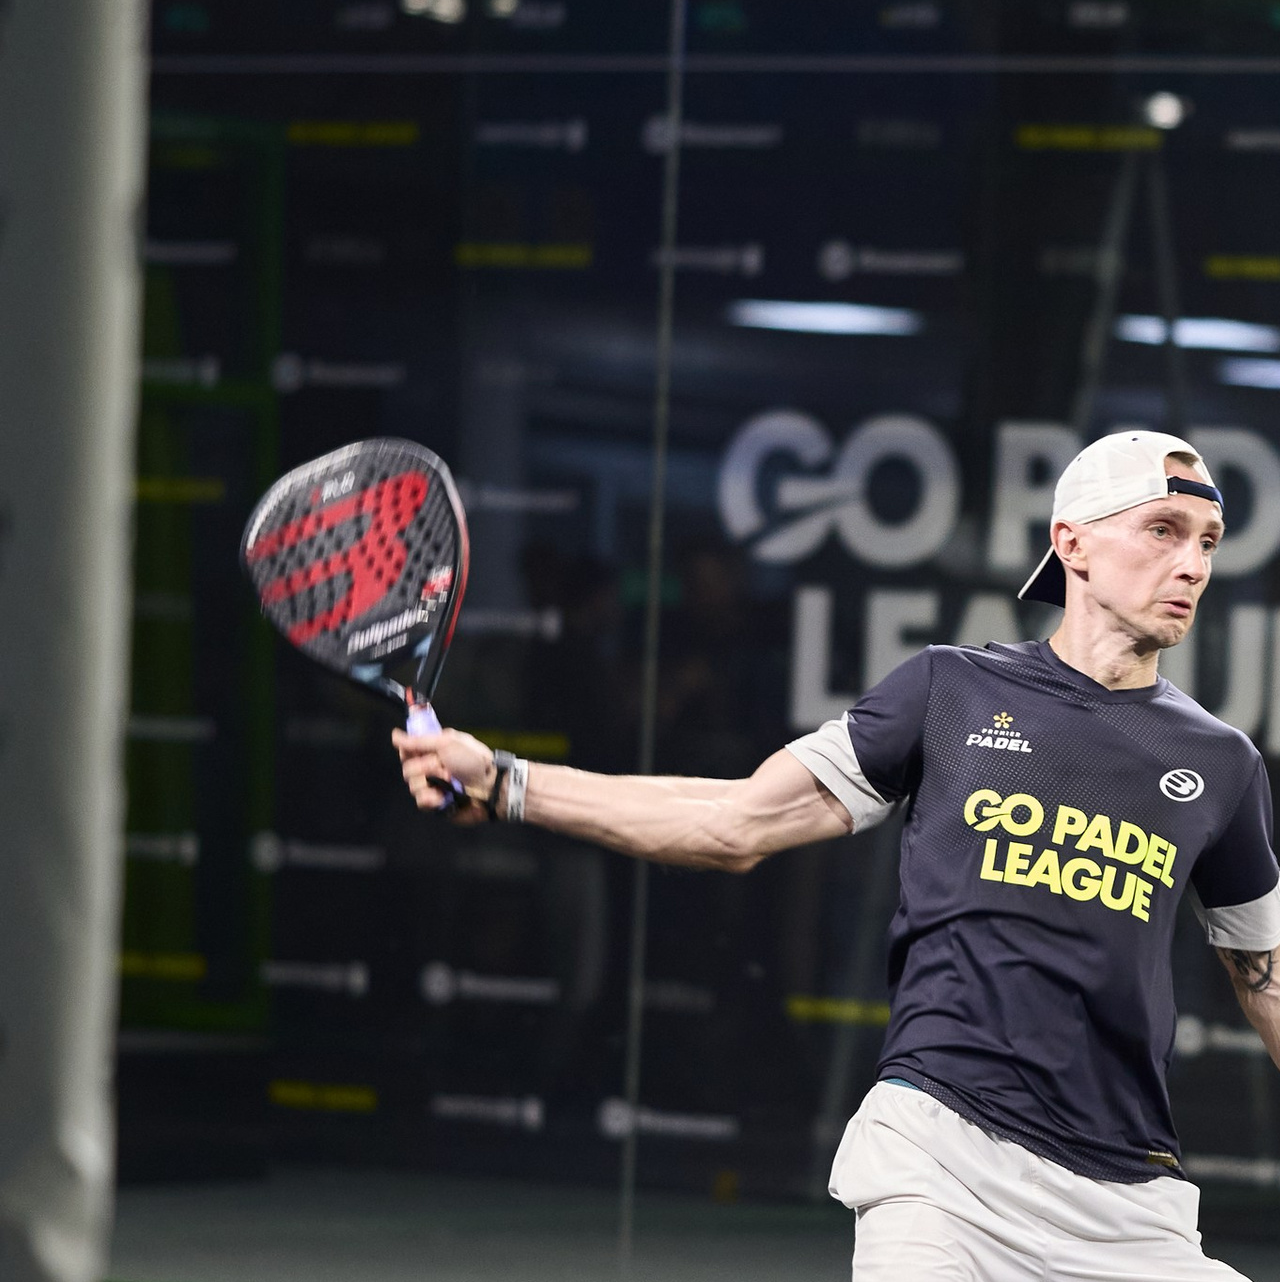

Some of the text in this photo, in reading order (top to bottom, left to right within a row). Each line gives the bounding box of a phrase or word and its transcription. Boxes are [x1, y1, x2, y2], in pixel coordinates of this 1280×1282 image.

[718, 409, 958, 567] GO
[966, 733, 1033, 753] PADEL
[981, 728, 1021, 738] PREMIER
[963, 788, 1178, 889] GO PADEL
[980, 838, 1154, 923] LEAGUE
